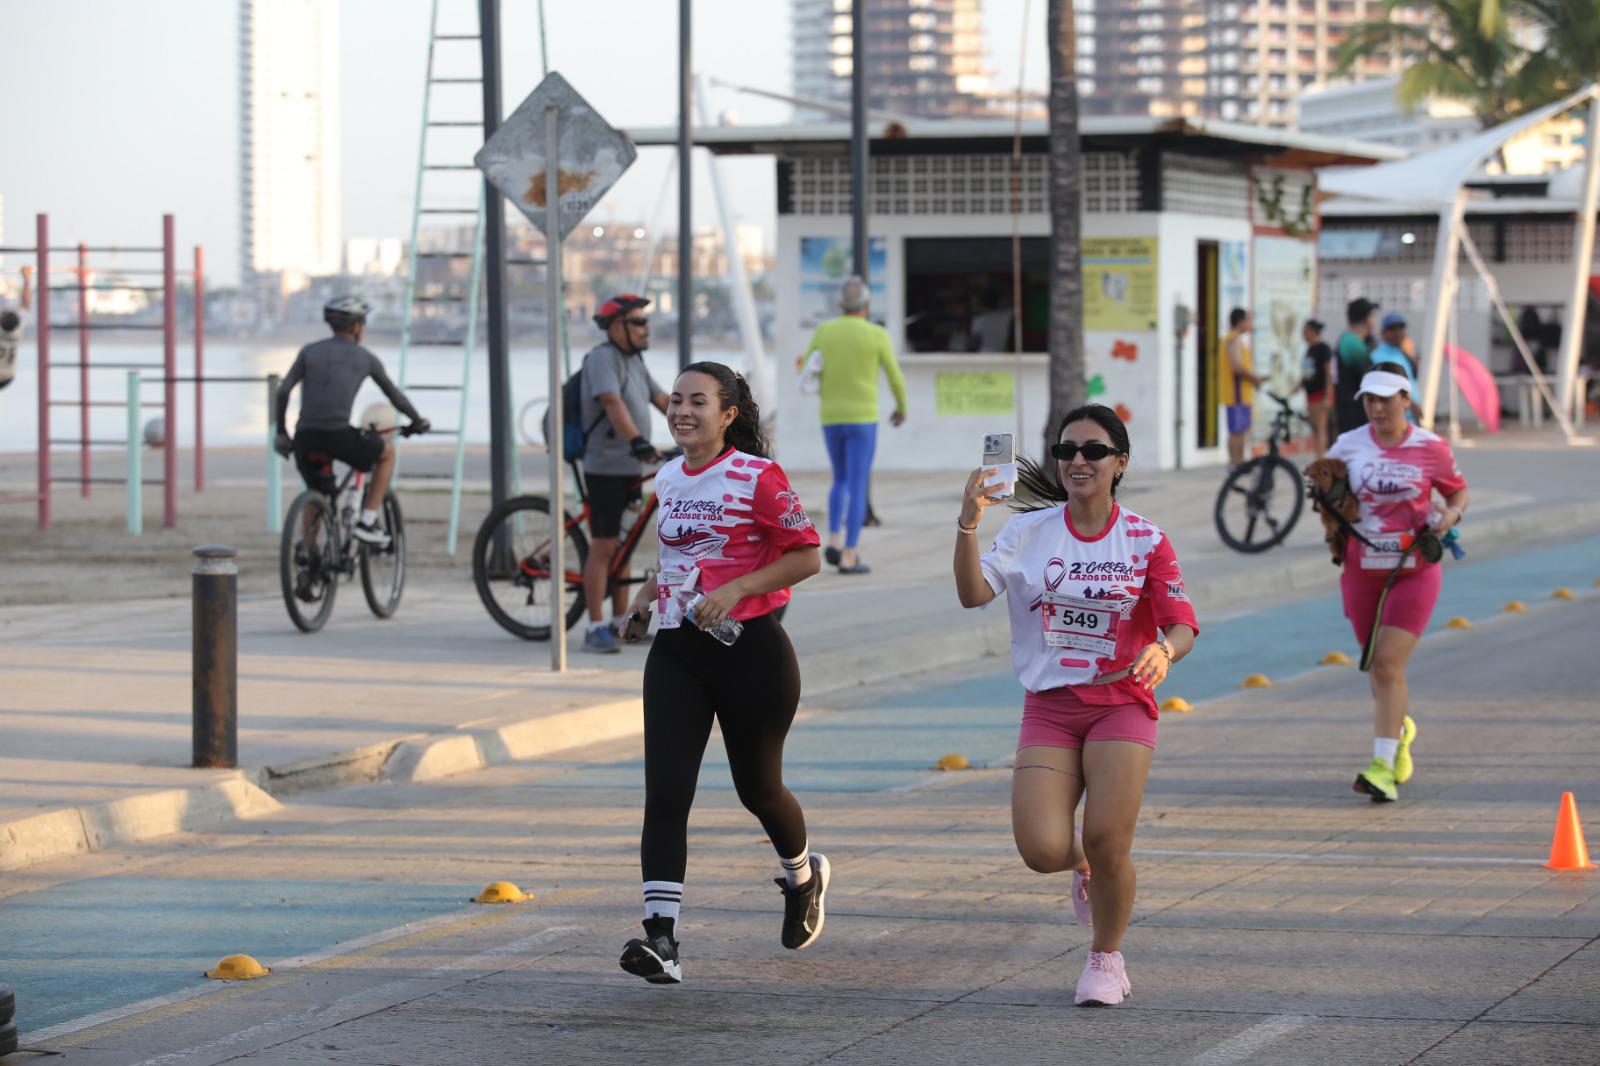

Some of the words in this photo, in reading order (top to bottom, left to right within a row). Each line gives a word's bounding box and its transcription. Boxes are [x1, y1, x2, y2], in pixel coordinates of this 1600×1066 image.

[683, 499, 724, 515] CARRERA
[670, 512, 691, 520] LAZOS
[703, 514, 723, 522] VIDA
[1086, 561, 1134, 575] CARRERA
[1069, 573, 1100, 581] LAZOS
[1101, 574, 1113, 582] DE
[1063, 609, 1098, 629] 549
